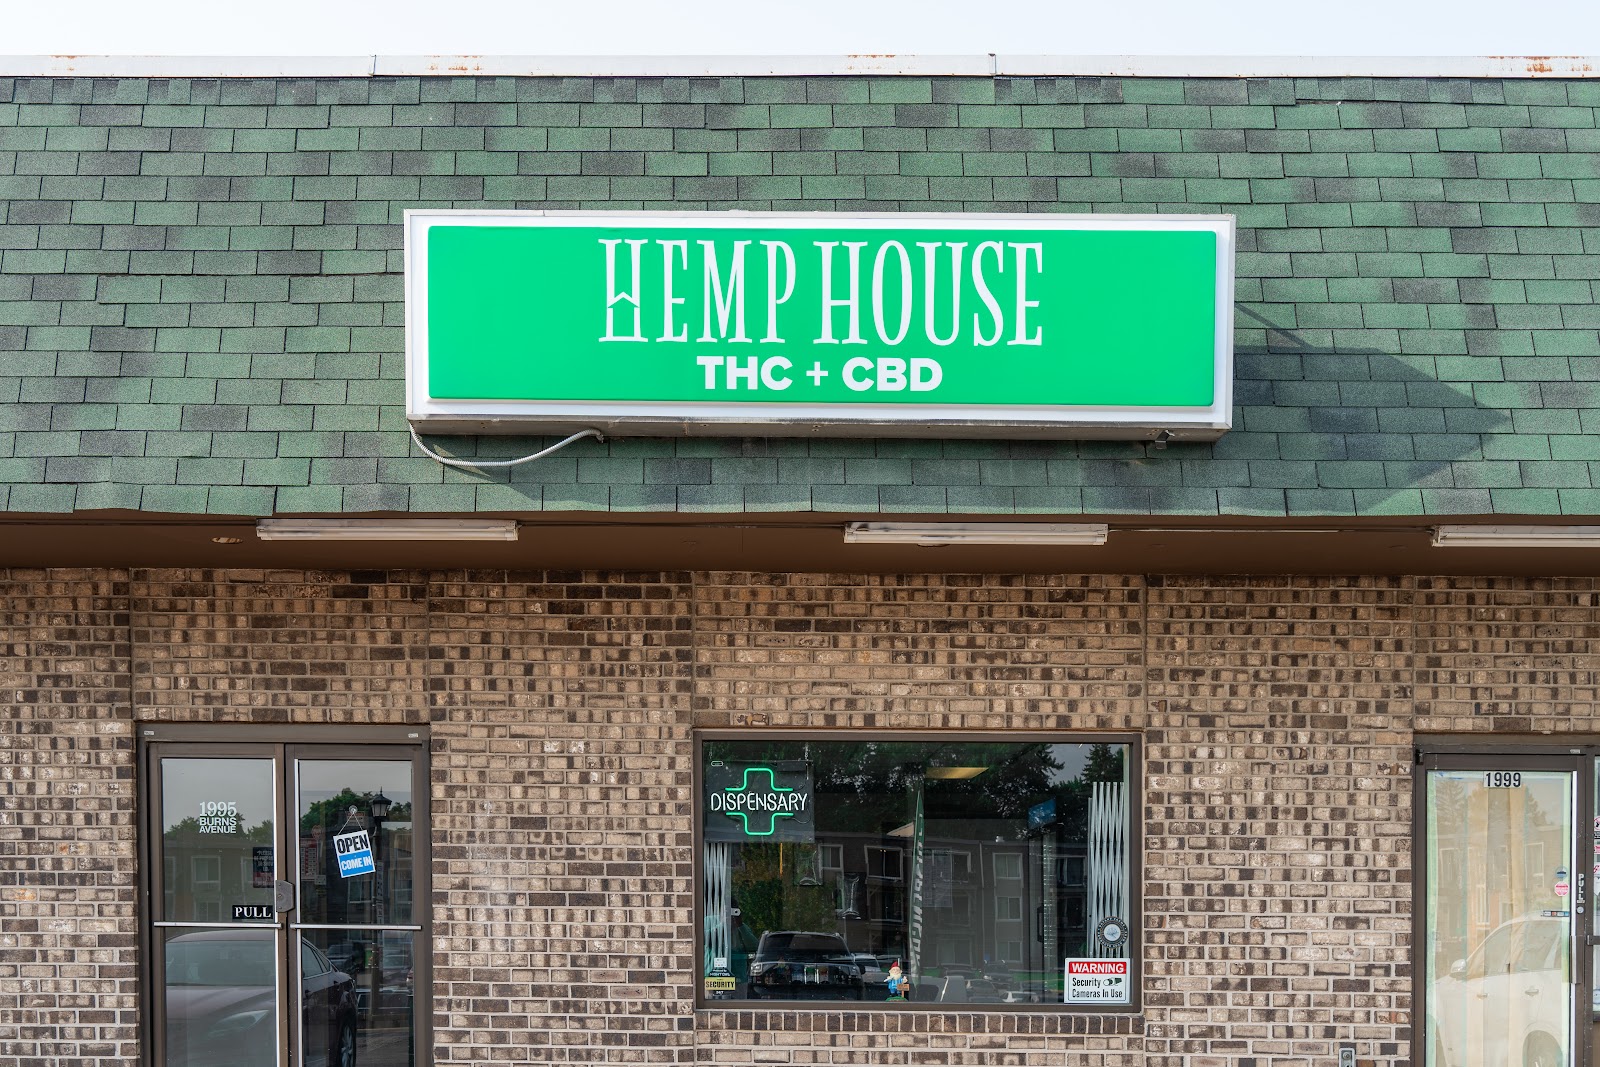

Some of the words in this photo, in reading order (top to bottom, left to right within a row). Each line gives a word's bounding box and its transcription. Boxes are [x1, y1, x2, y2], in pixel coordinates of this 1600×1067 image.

[598, 239, 797, 344] HEMP
[813, 240, 1043, 346] HOUSE
[696, 355, 793, 391] THC
[805, 361, 829, 386] +
[842, 356, 943, 392] CBD
[1486, 772, 1522, 787] 1999
[199, 801, 237, 817] 1995
[710, 792, 808, 811] DISPENSARY
[199, 817, 237, 826] BURNS
[198, 825, 237, 834] AVENUE
[336, 833, 370, 854] OPEN
[341, 857, 364, 871] COME
[363, 855, 372, 867] IN
[1577, 873, 1585, 900] PULL
[234, 906, 272, 918] PULL
[1071, 963, 1125, 973] WARNING
[1072, 977, 1101, 988] Security
[1072, 988, 1101, 998] Cameras
[1102, 988, 1109, 998] In
[1110, 988, 1123, 998] Use
